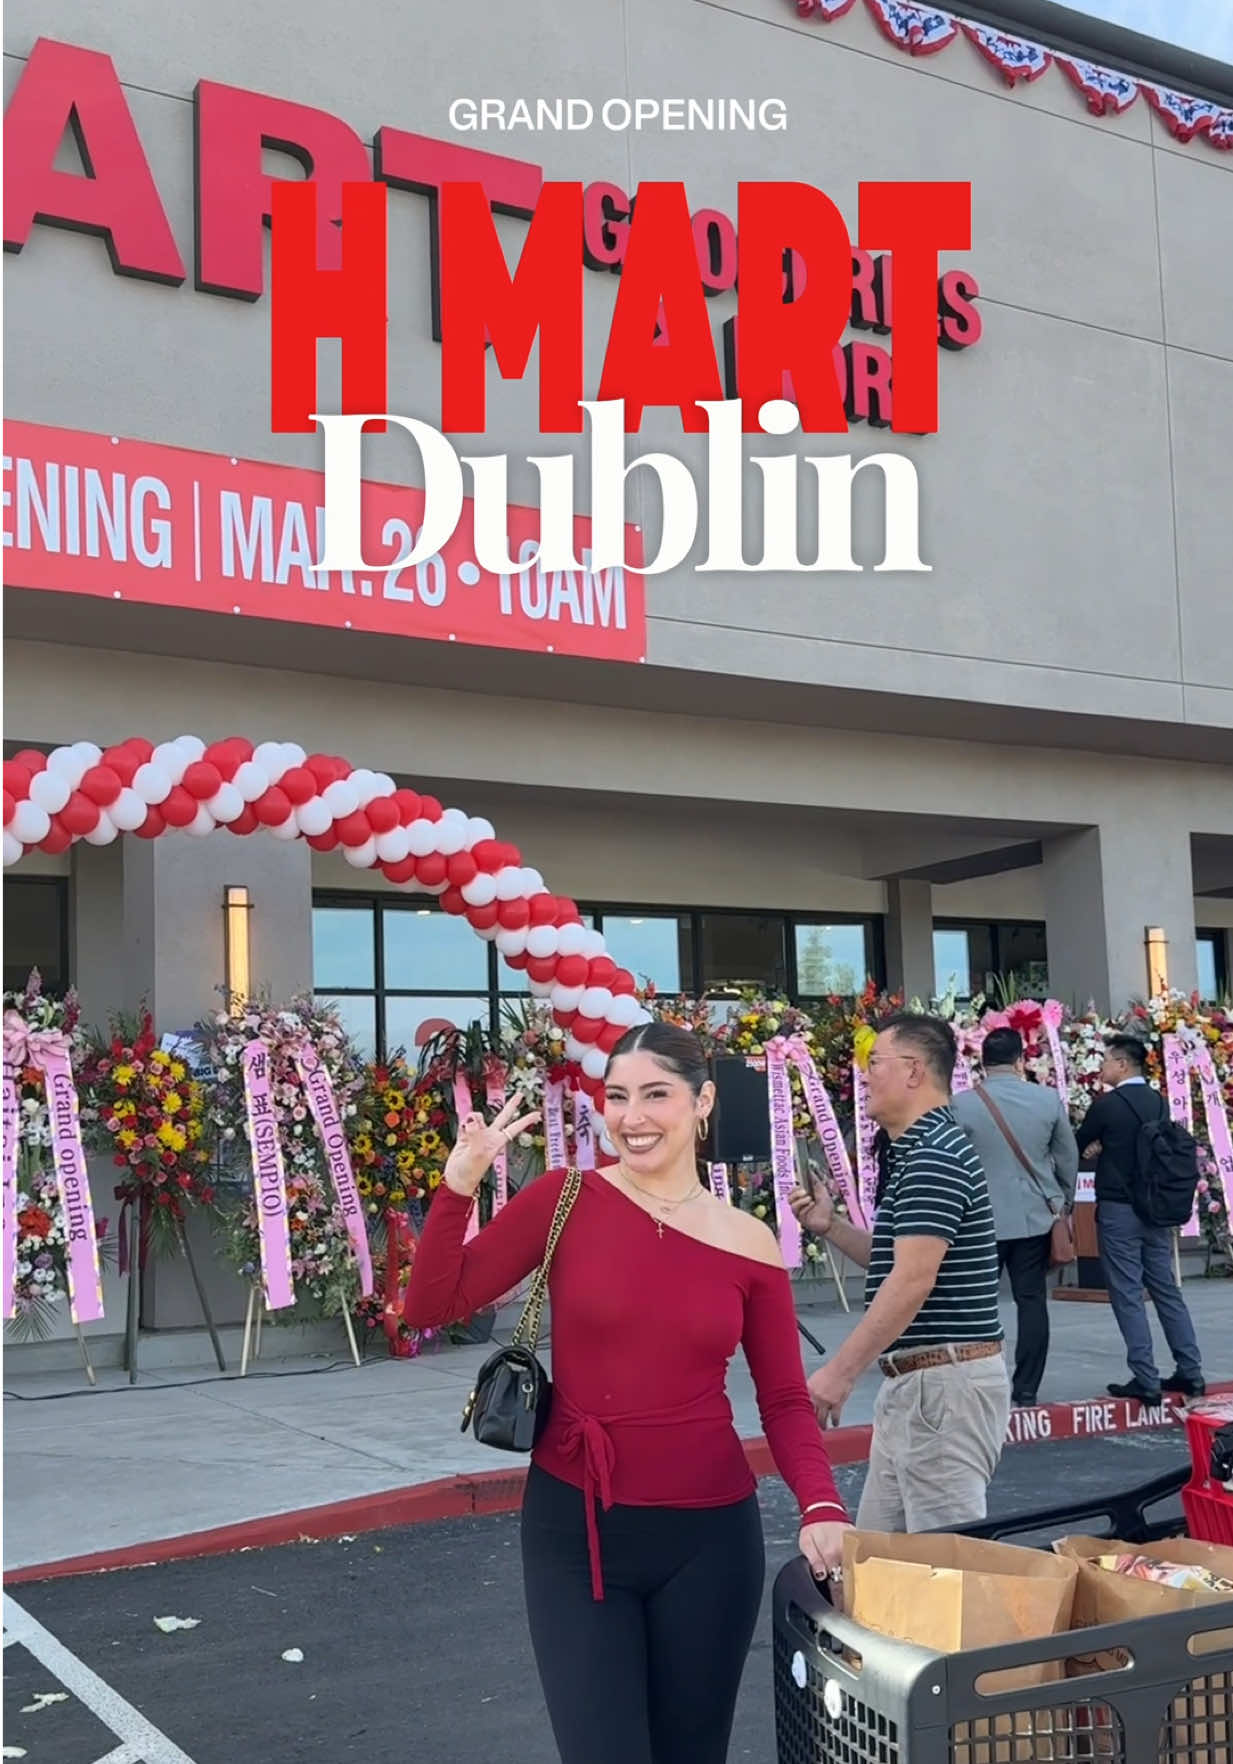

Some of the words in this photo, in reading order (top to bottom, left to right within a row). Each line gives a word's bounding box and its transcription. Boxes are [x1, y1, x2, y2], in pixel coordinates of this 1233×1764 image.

[53, 1073, 78, 1140] Grand
[773, 1116, 789, 1146] Asian
[808, 1074, 833, 1123] Grand
[822, 1128, 851, 1197] Opening
[308, 1070, 339, 1128] Grand
[327, 1134, 358, 1217] Opening
[774, 1148, 791, 1178] Foods
[59, 1148, 88, 1241] opening
[1073, 1403, 1117, 1434] FIRE
[1125, 1398, 1173, 1428] LANE
